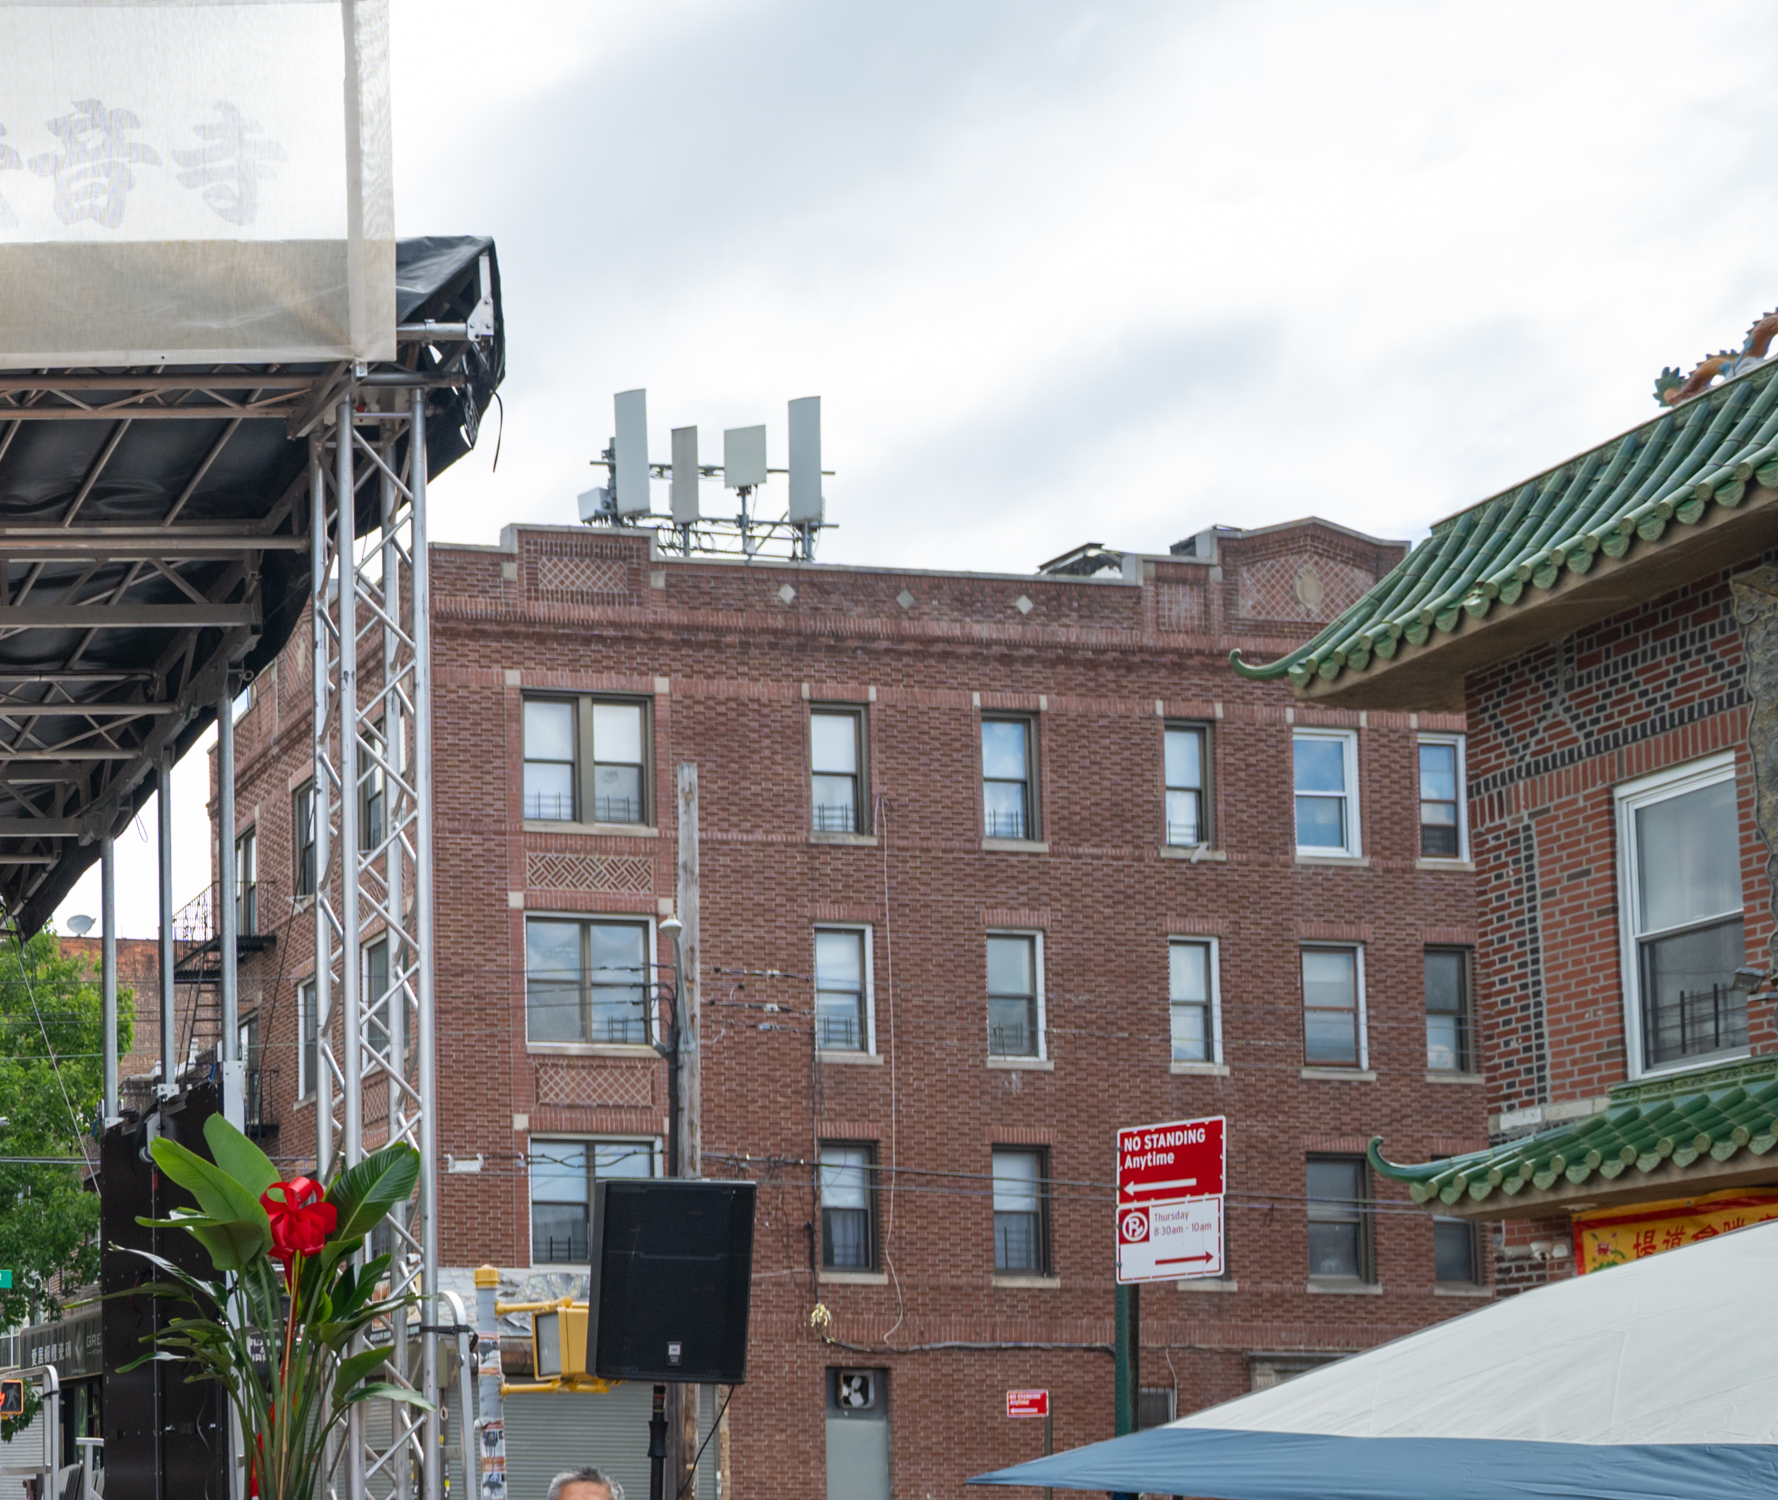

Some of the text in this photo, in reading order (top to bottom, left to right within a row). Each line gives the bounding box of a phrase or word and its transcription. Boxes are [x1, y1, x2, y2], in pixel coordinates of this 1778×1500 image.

[1124, 1128, 1206, 1152] NO STANDING
[1124, 1151, 1175, 1170] Anytime
[1154, 1211, 1189, 1223] Thursday
[1154, 1225, 1183, 1236] 8:30am
[1191, 1222, 1212, 1232] 10am
